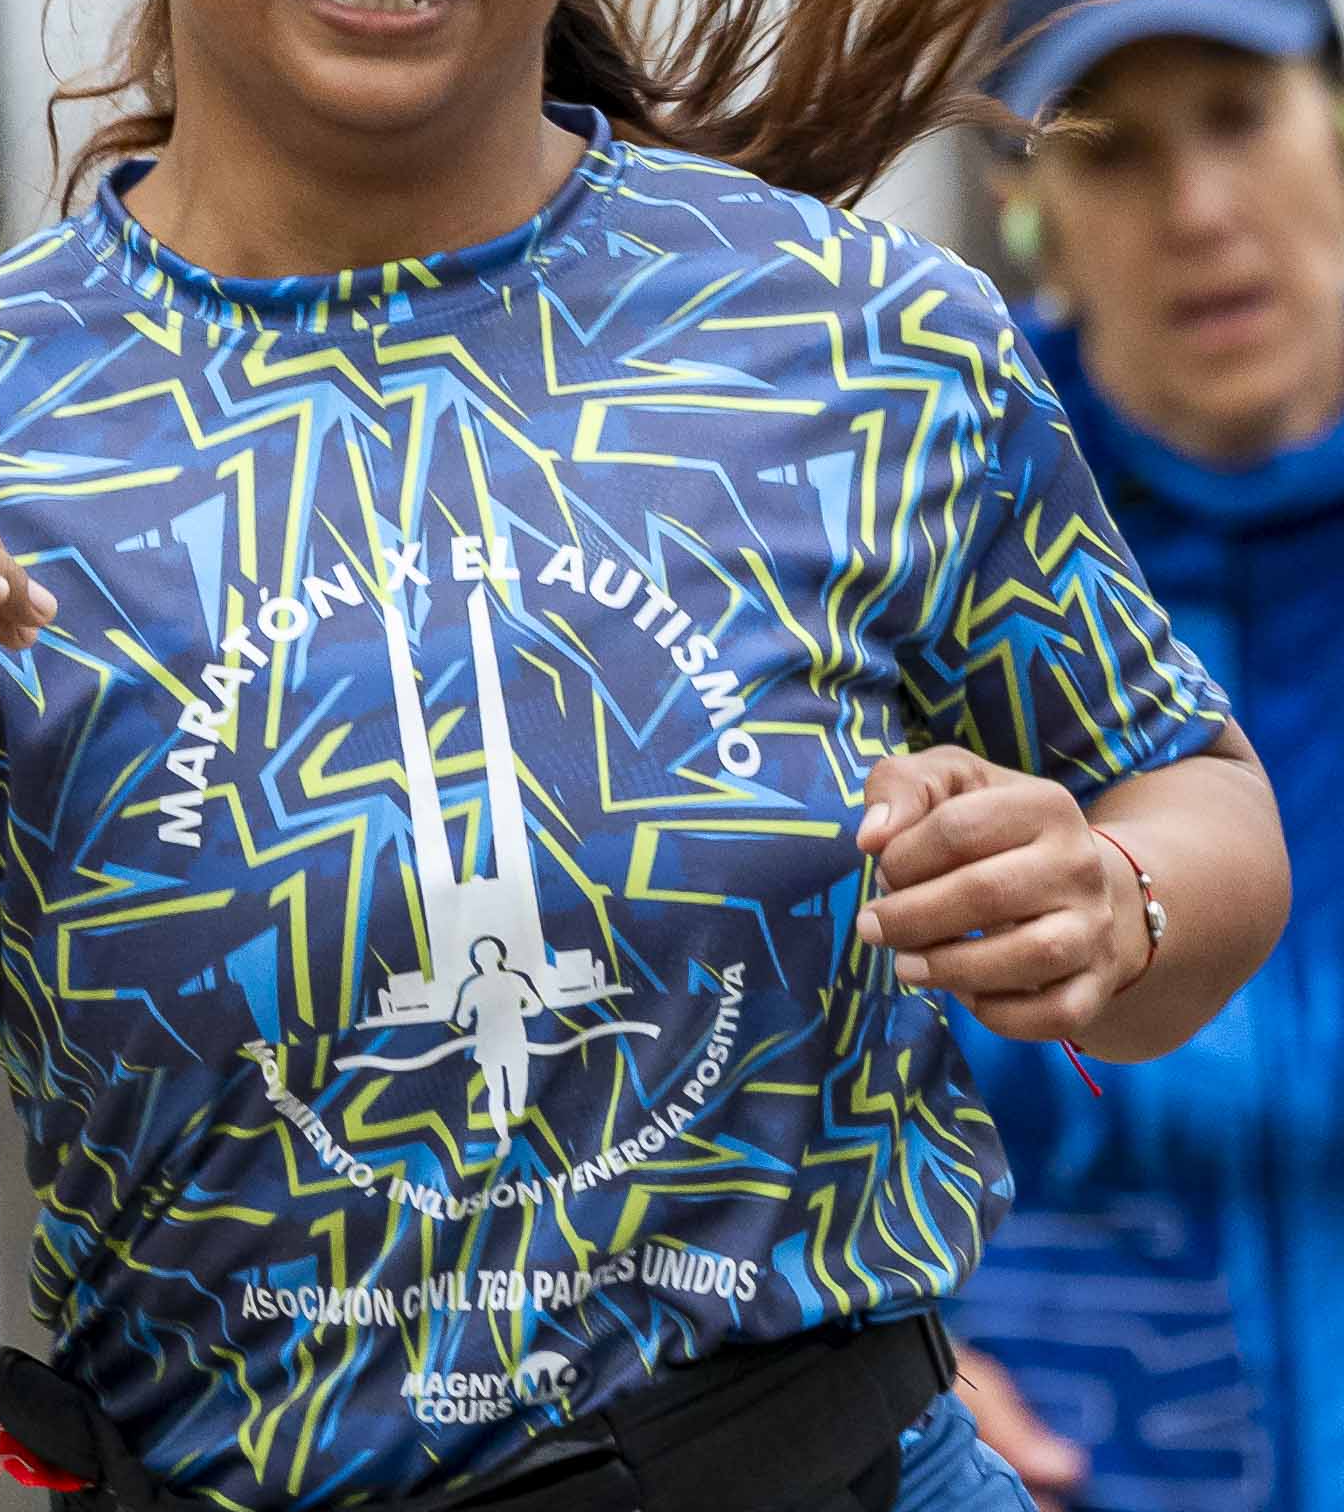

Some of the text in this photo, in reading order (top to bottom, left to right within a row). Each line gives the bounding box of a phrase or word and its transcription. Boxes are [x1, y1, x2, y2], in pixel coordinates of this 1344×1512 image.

[158, 535, 761, 847] MARATÓN X EL AUTISMO
[546, 1173, 567, 1200] Y
[572, 1103, 694, 1192] ENERGÍA
[683, 961, 746, 1105] POSITIVA
[403, 1270, 472, 1320] CIVIL
[477, 1270, 525, 1311] TGD
[641, 1244, 758, 1302] UNIDOS
[400, 1372, 509, 1399] MAGNY
[416, 1396, 513, 1425] COURS
